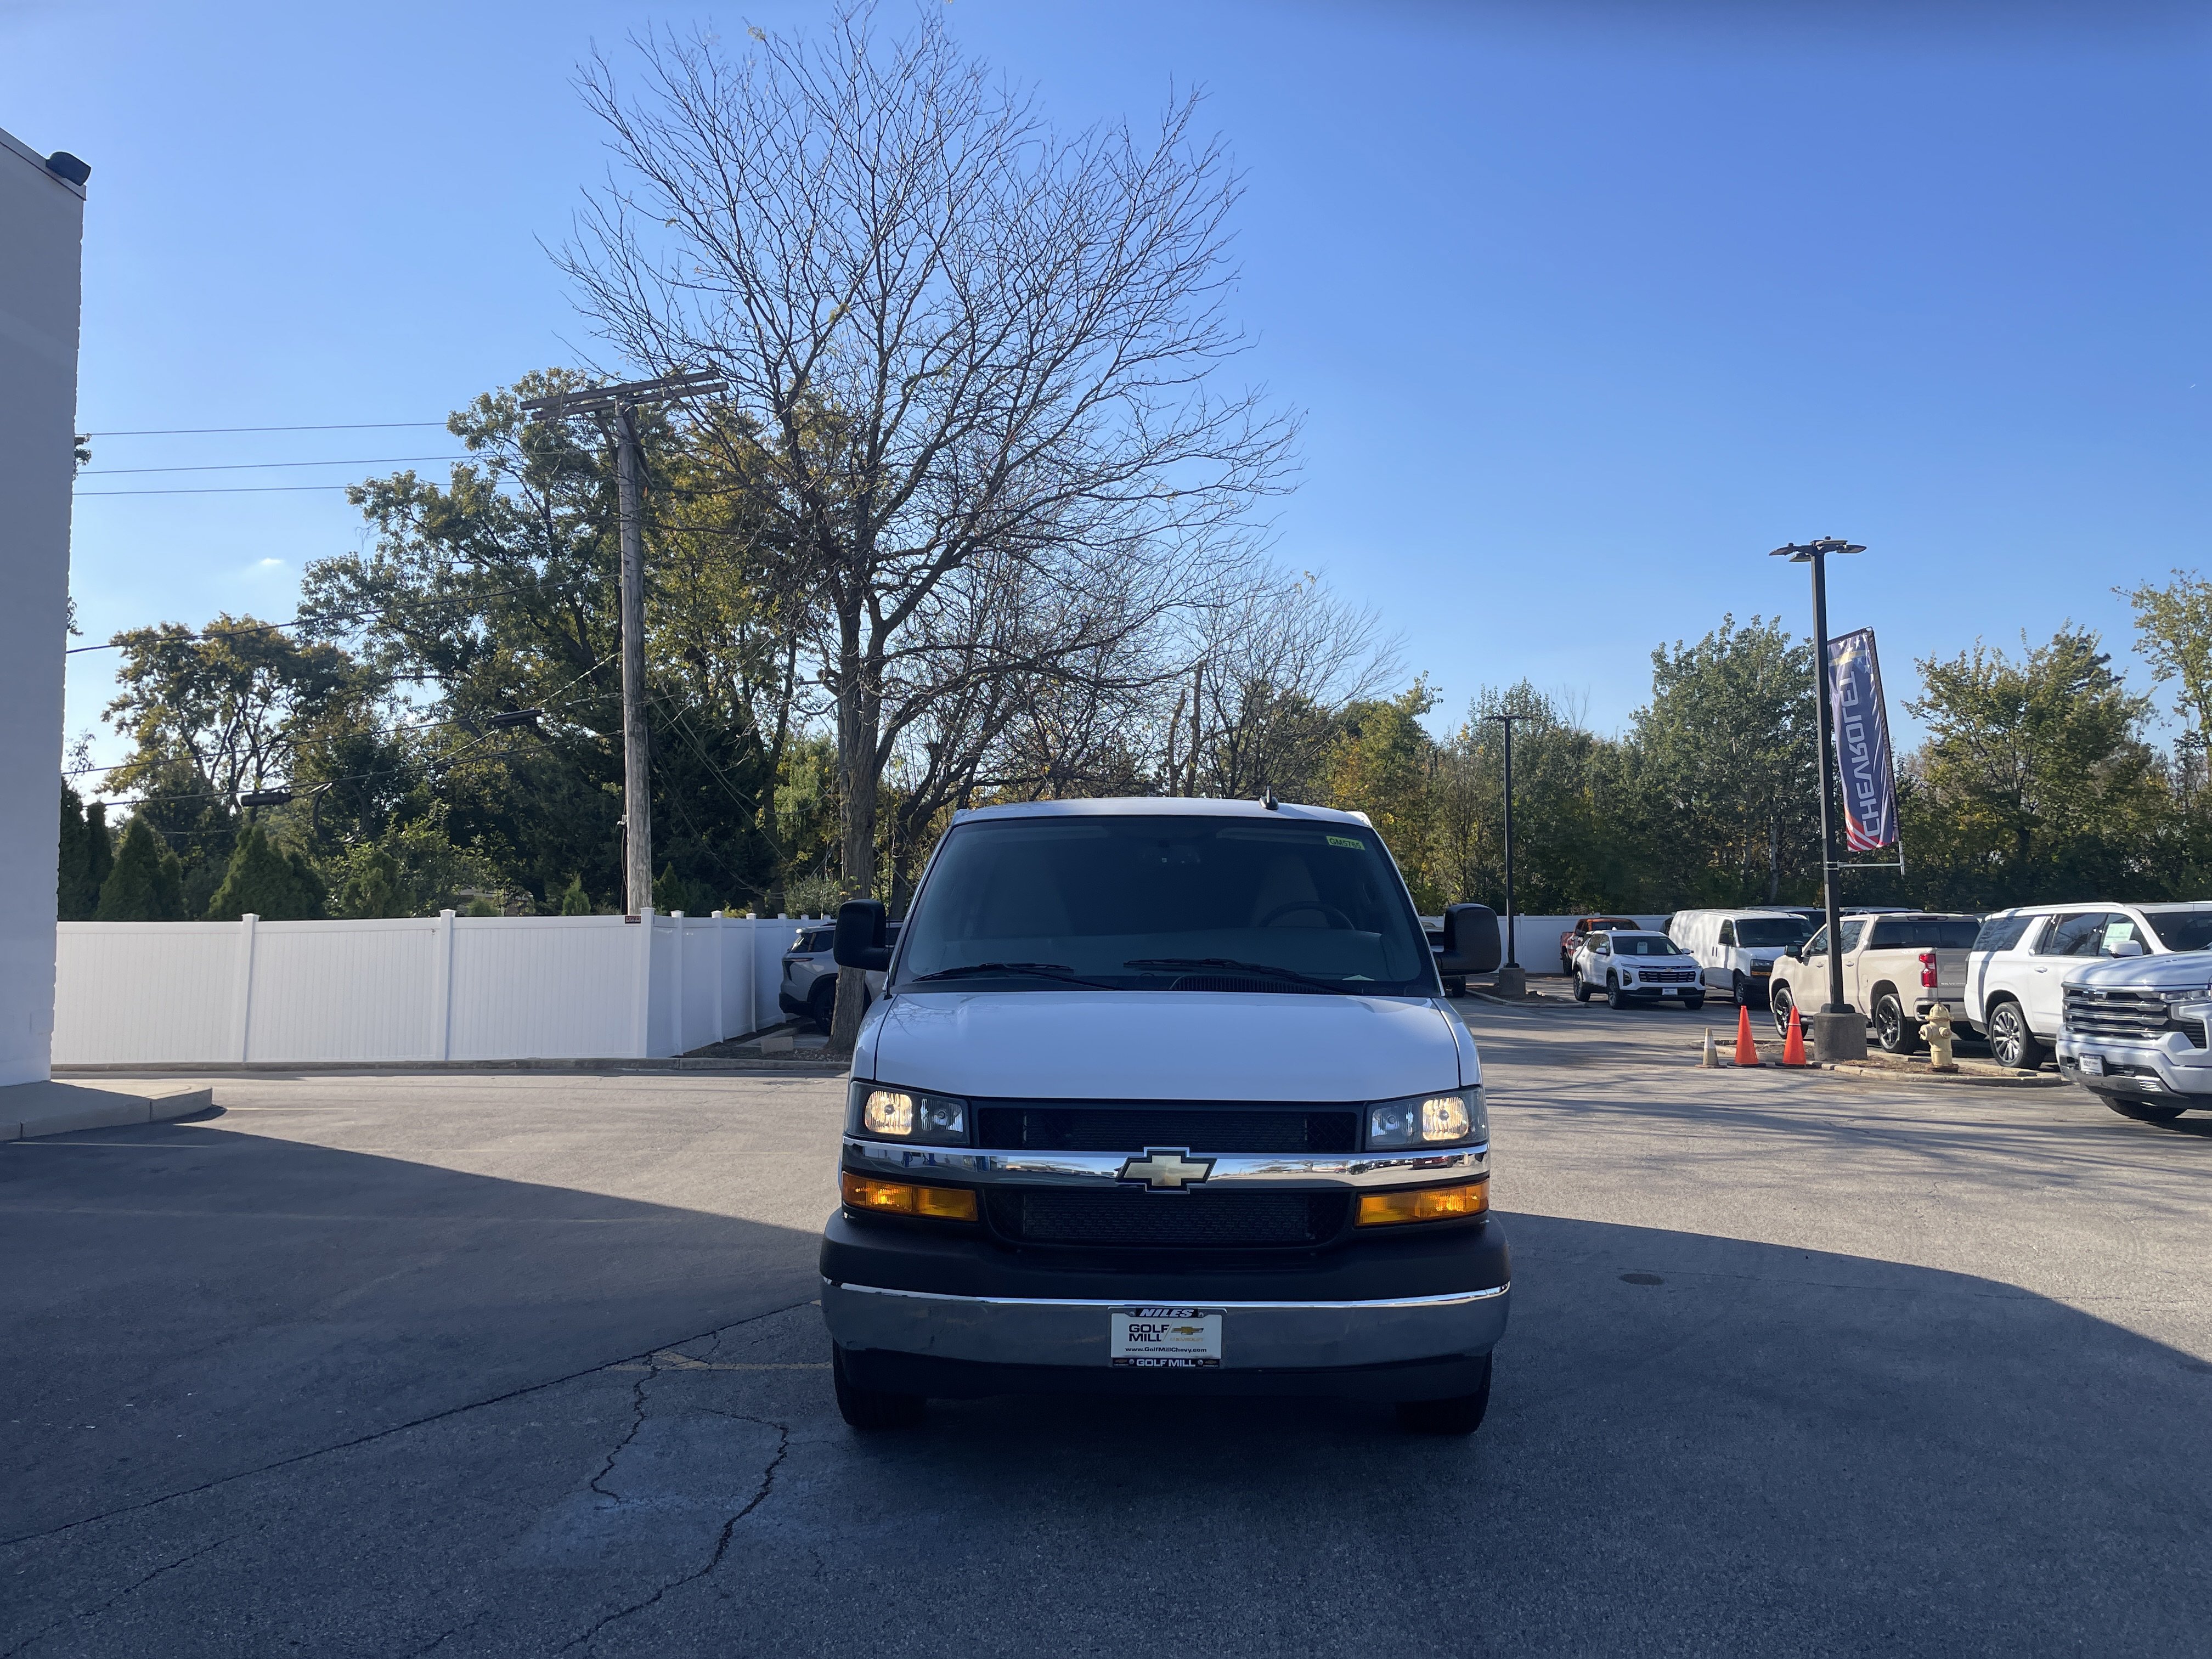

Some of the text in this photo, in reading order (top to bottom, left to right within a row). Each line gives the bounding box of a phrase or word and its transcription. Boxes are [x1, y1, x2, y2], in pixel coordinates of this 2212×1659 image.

[1329, 838, 1362, 849] GM5765
[1139, 1308, 1194, 1317] NILES
[1128, 1324, 1170, 1333] GOLF
[1128, 1333, 1162, 1342] MILL
[1168, 1359, 1196, 1367] MILL
